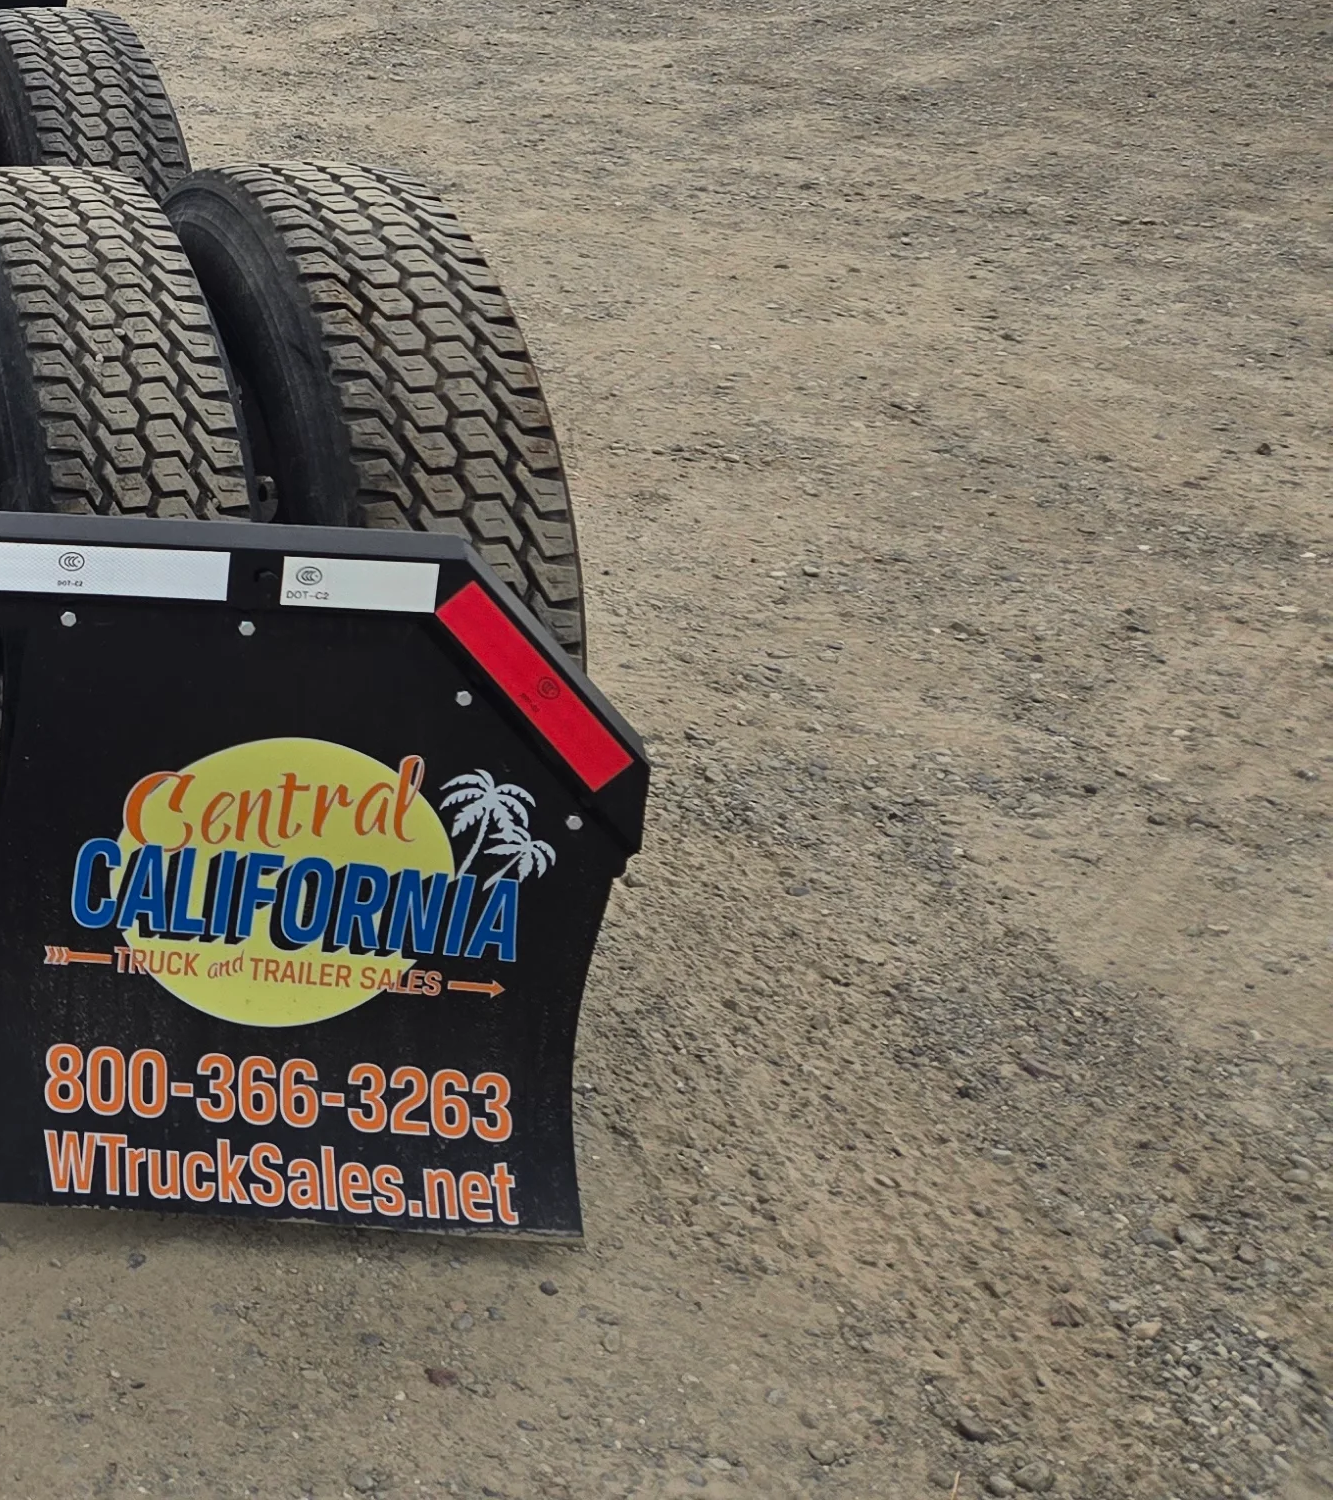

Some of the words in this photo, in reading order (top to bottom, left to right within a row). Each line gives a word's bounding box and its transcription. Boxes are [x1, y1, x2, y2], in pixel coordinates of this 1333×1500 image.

[286, 590, 330, 600] DOT-C2
[122, 754, 425, 853] Central
[71, 837, 520, 962] CALIFORNIA
[114, 946, 199, 977] TRUCK
[206, 949, 245, 980] and
[249, 958, 352, 988] TRAILER
[360, 967, 443, 997] SALES
[44, 1043, 513, 1143] 800-366-3263
[44, 1129, 520, 1225] WTruckSales.net
